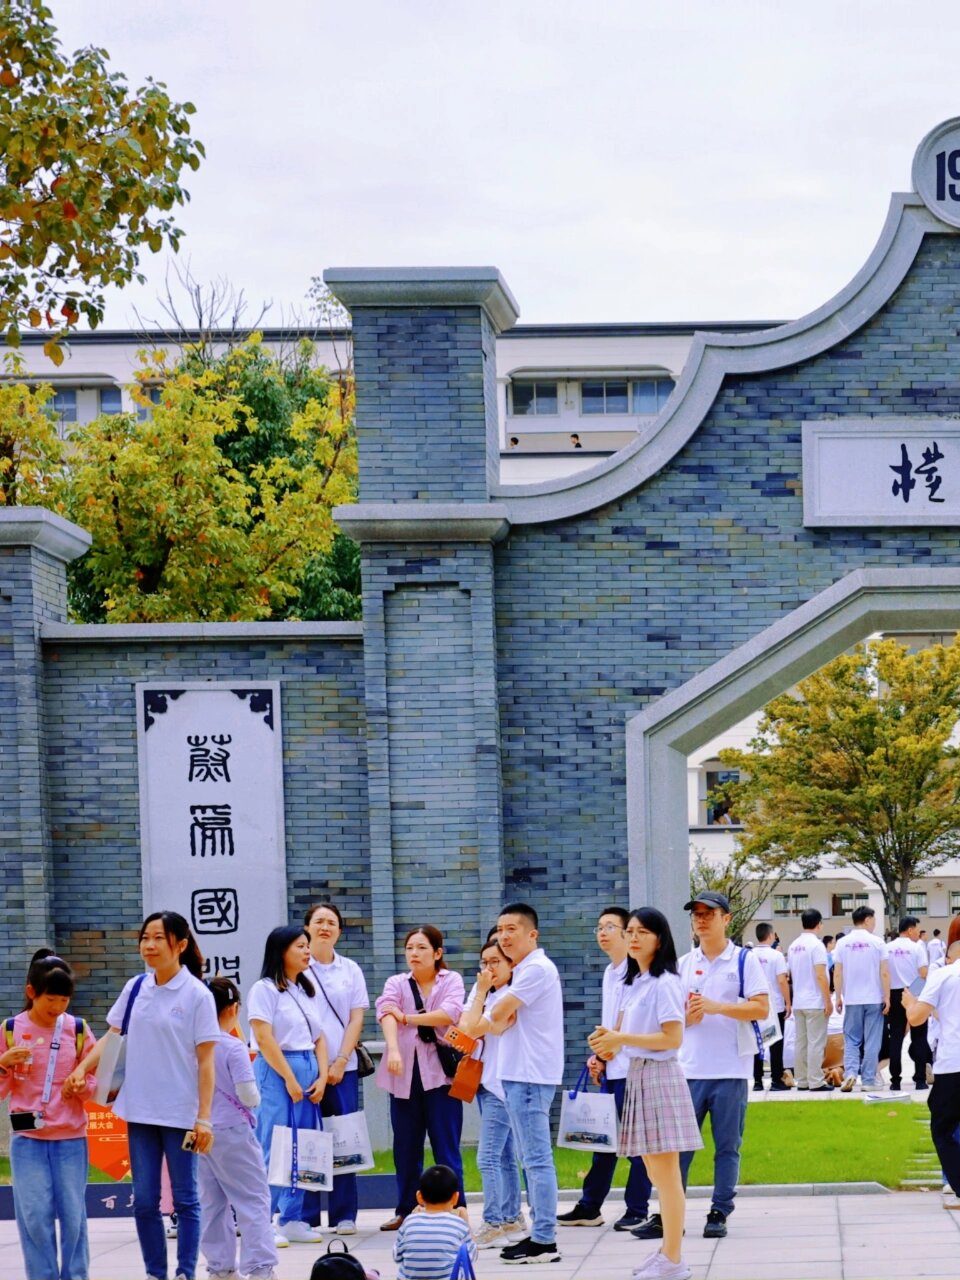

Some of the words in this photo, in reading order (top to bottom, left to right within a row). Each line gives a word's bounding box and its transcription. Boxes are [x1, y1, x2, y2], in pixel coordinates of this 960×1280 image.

[88, 1111, 121, 1121] 震泽中
[87, 1121, 114, 1130] 展大会
